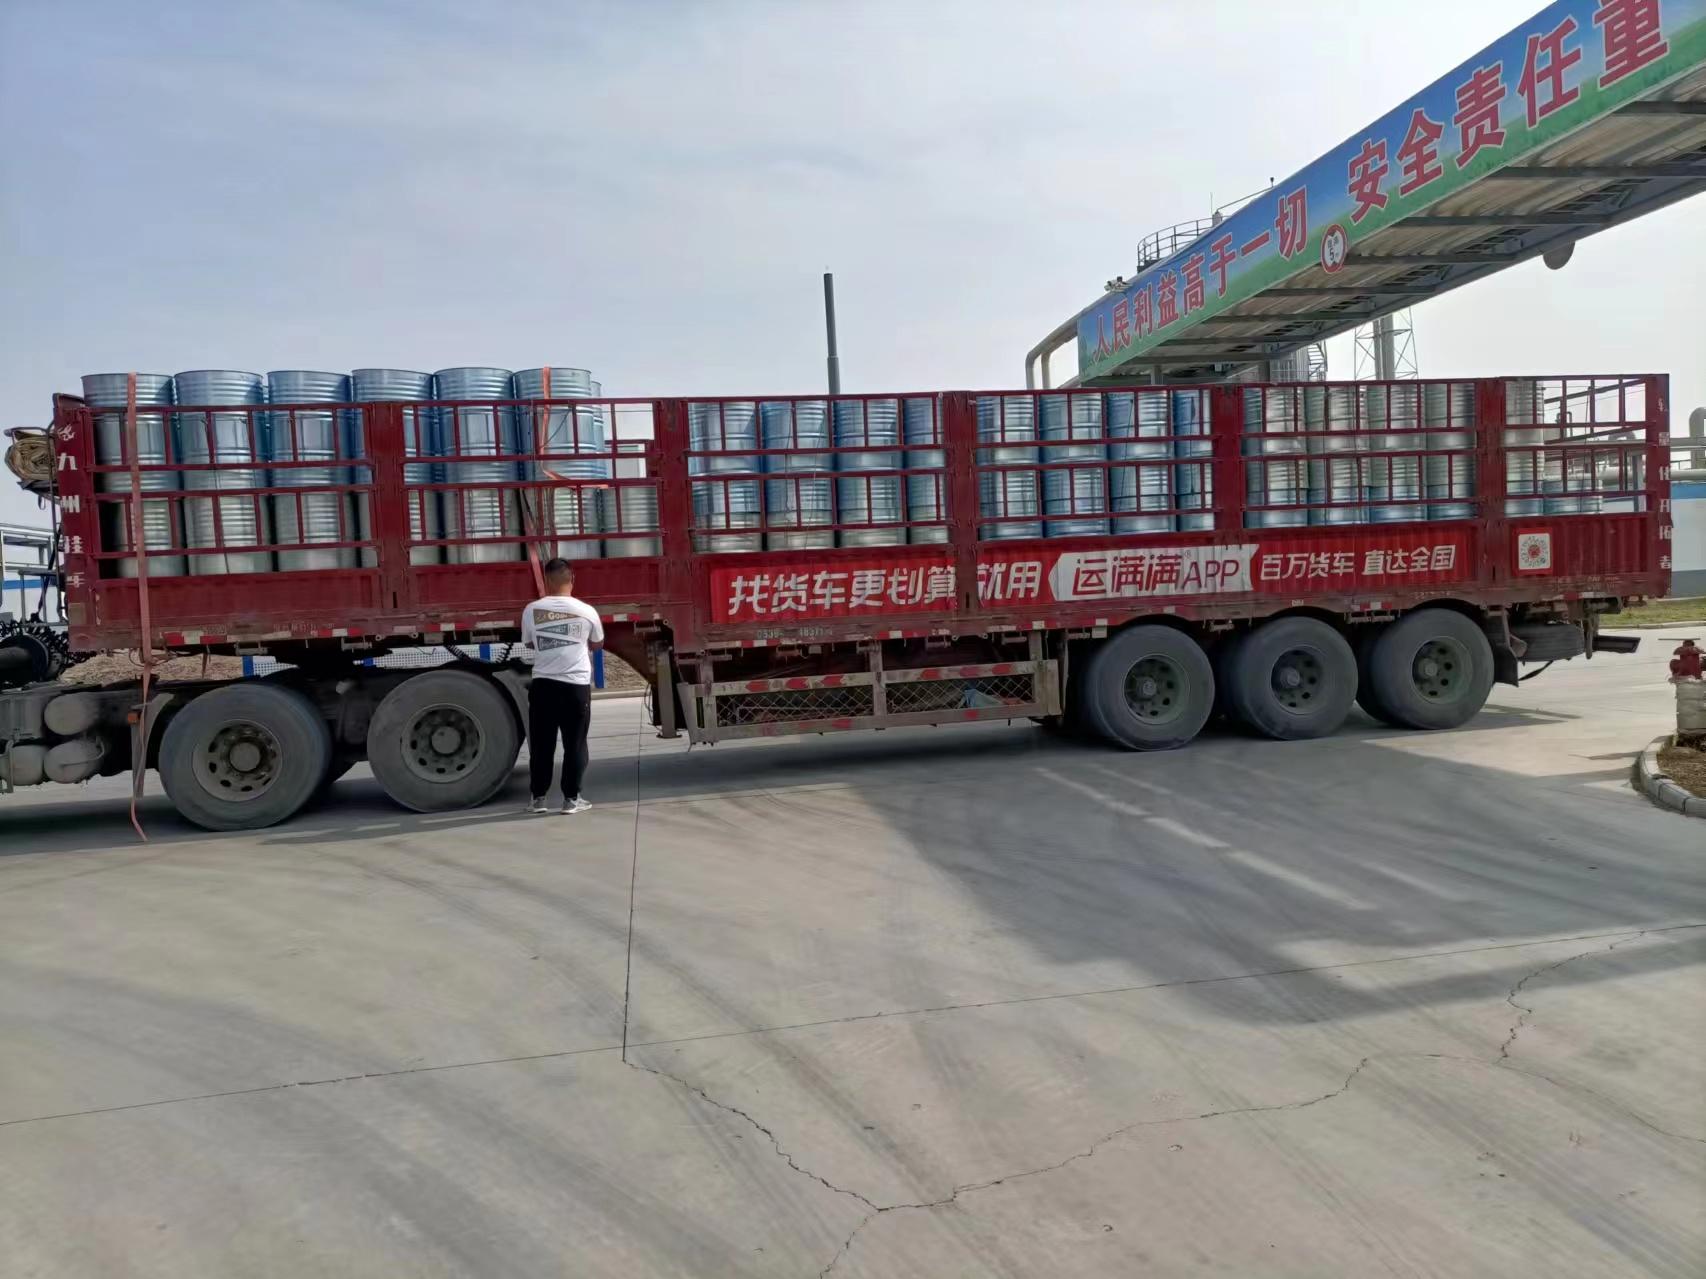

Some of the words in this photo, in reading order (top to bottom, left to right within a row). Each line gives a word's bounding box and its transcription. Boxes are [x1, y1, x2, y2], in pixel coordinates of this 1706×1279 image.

[1092, 186, 1308, 362] 人民利益高于一切
[1347, 0, 1669, 224] 安全责任重
[728, 565, 957, 616] 找货车更划算
[976, 561, 1042, 600] 就用
[1072, 553, 1240, 596] 运满满APP
[1260, 551, 1355, 581] 百万货车
[1361, 544, 1456, 576] 直达全国
